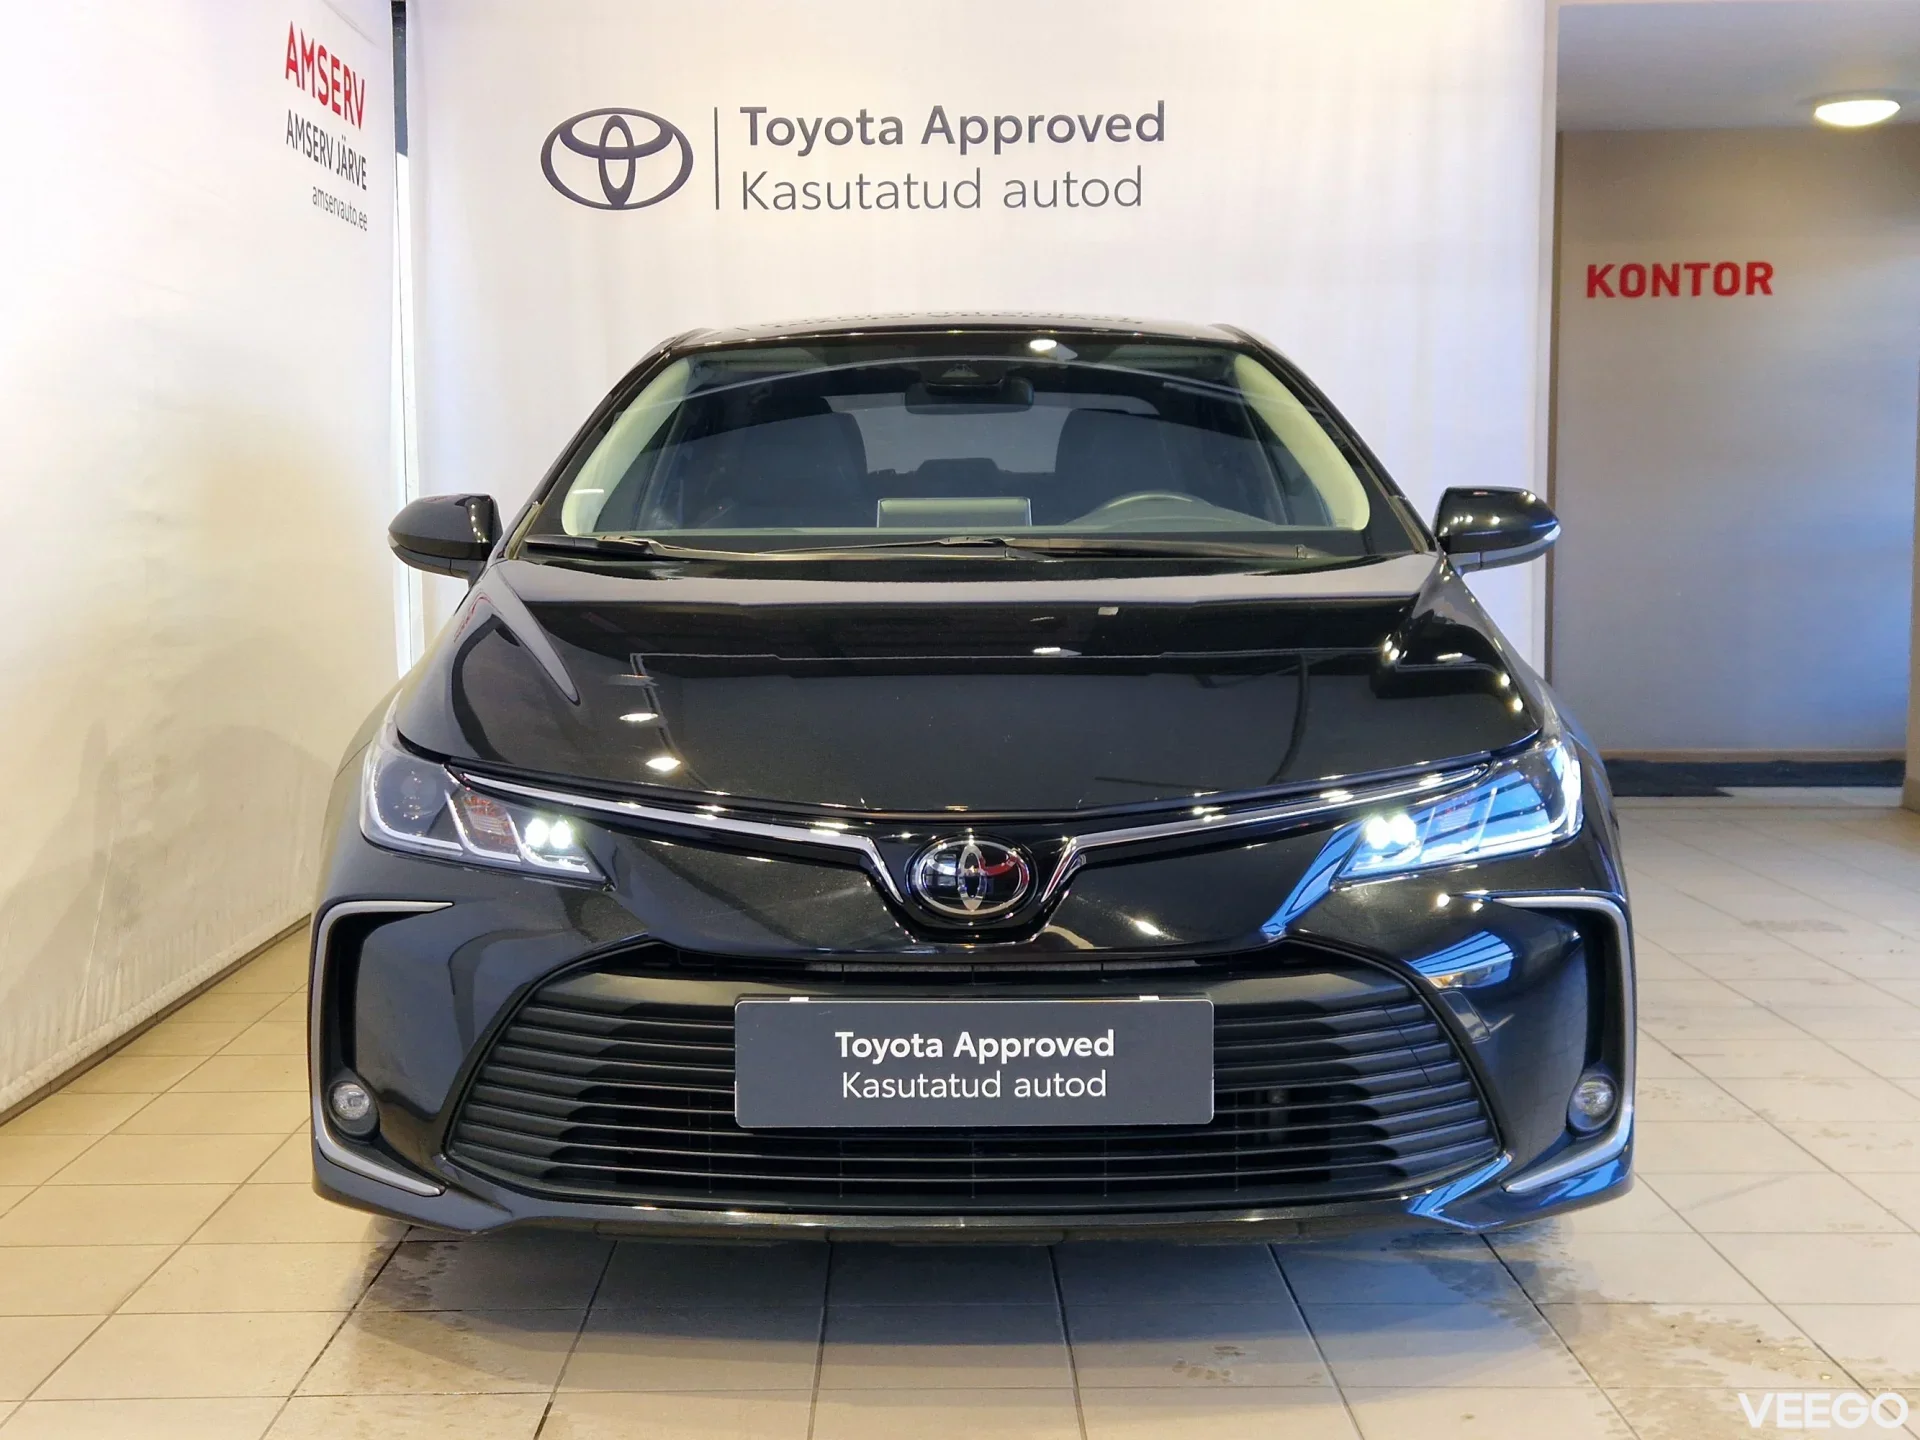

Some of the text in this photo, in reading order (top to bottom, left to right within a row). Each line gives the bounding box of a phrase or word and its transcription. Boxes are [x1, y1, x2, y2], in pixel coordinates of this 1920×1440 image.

[285, 21, 365, 129] AMSERV
[286, 110, 367, 190] AMSERV JÄRVE
[740, 100, 1165, 156] Toyota Approved
[312, 185, 368, 231] amservauto.ee
[742, 166, 1142, 211] Kasutatud autod
[1587, 262, 1773, 298] KONTOR
[835, 1029, 1115, 1064] Toyota Approved
[842, 1070, 1107, 1099] Kasutatud autod
